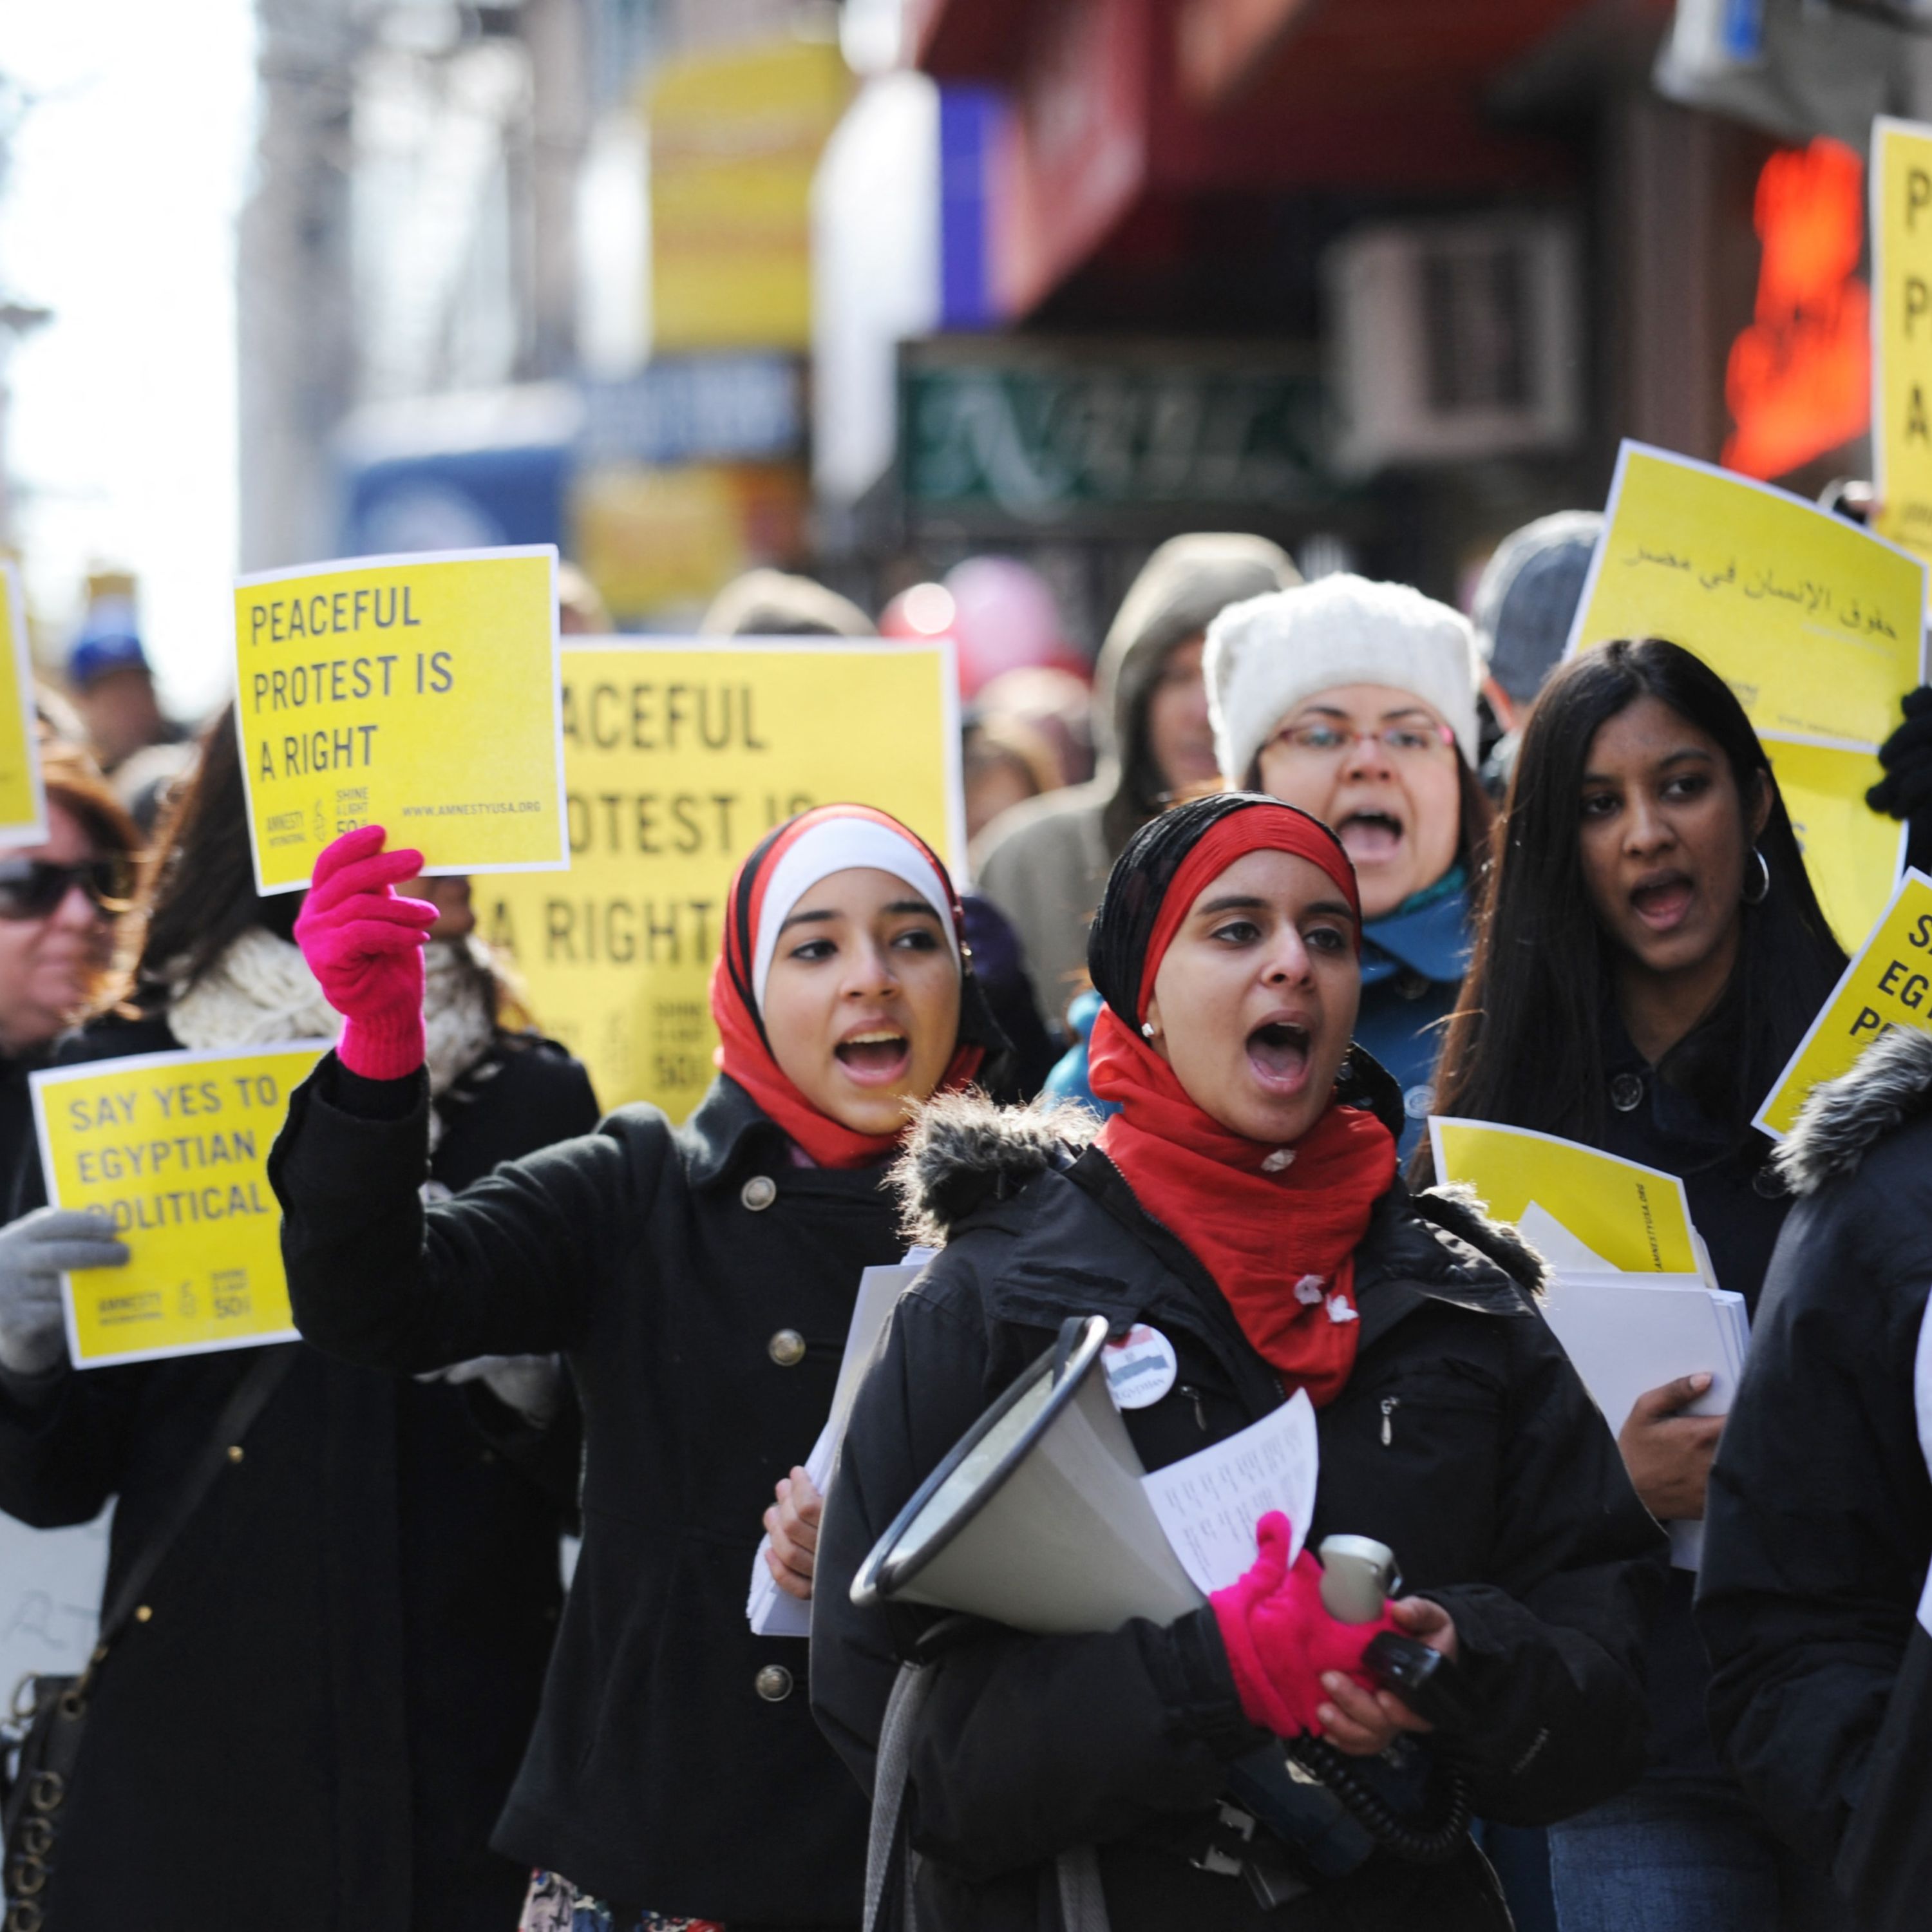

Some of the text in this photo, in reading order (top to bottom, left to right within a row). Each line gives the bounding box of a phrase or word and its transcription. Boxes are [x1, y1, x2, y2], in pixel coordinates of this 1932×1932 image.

[251, 585, 421, 647] PEACEFUL
[253, 650, 454, 714] PROTEST IS
[260, 724, 379, 782] A RIGHT
[402, 800, 542, 818] WWW.AMNESTYUSA.ORG
[545, 897, 712, 967] RIGHT
[1908, 914, 1932, 956] S
[1877, 959, 1932, 1020] EG
[68, 1074, 278, 1133] SAY YES TO
[77, 1128, 258, 1186] EGYPTIAN
